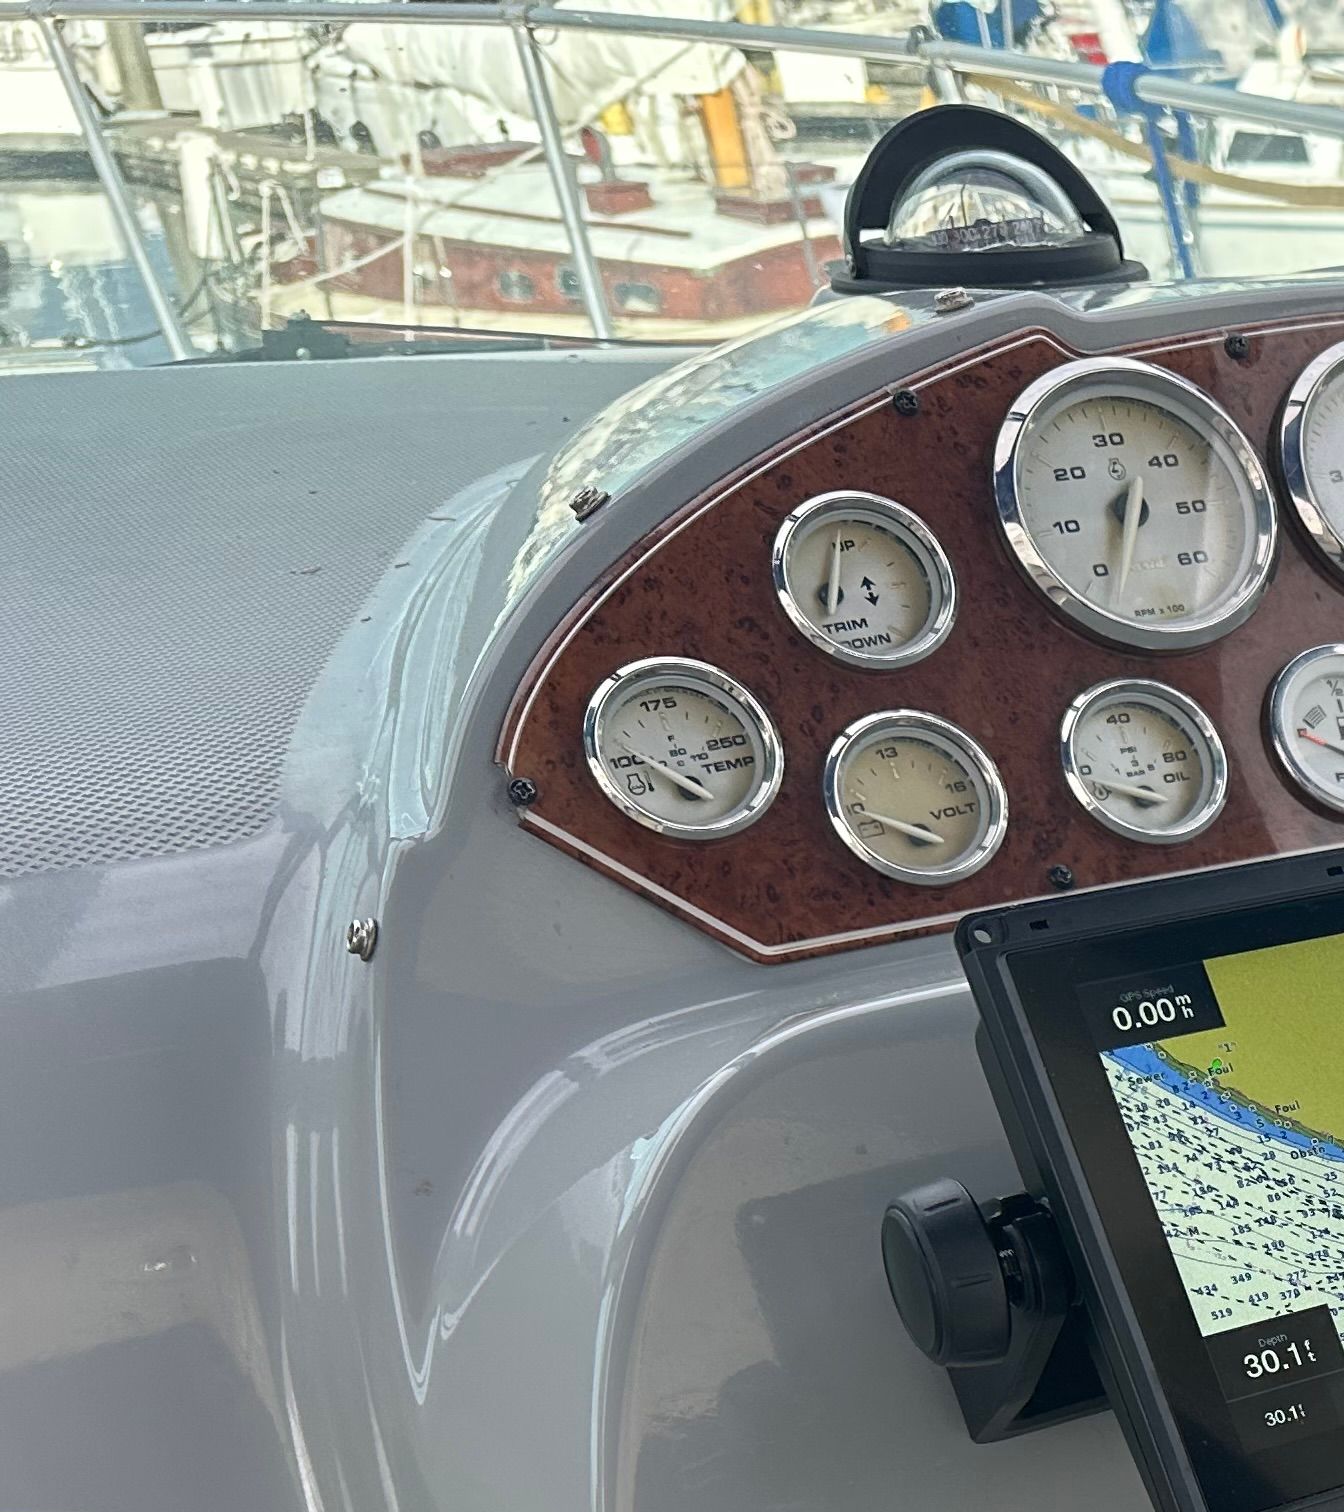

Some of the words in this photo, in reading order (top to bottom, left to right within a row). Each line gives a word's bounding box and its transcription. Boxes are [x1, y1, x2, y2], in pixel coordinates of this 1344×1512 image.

[1093, 432, 1124, 447] 30
[1148, 454, 1179, 468] 40
[1053, 466, 1086, 481] 20
[1176, 500, 1206, 514] 50
[1053, 520, 1080, 534] 10
[1178, 550, 1208, 565] 60
[1093, 564, 1109, 577] 0
[1135, 607, 1156, 617] RPM
[1167, 604, 1185, 613] 100
[823, 618, 869, 634] TRIM
[640, 697, 677, 712] 175
[1106, 713, 1130, 724] 40
[706, 735, 746, 751] 250
[876, 747, 898, 759] 13
[1163, 751, 1187, 763] 80
[701, 755, 755, 773] TEMP
[1080, 765, 1092, 776] 0
[1163, 772, 1191, 783] OIL
[945, 781, 967, 793] 16
[846, 802, 865, 816] 10
[930, 802, 976, 820] VOLT
[1112, 999, 1175, 1031] 0.00
[1208, 1064, 1234, 1077] Foul
[1275, 1101, 1300, 1115] Foul
[1290, 1145, 1325, 1160] Obstn
[1258, 1333, 1287, 1348] Depth
[1244, 1342, 1303, 1378] 30.1
